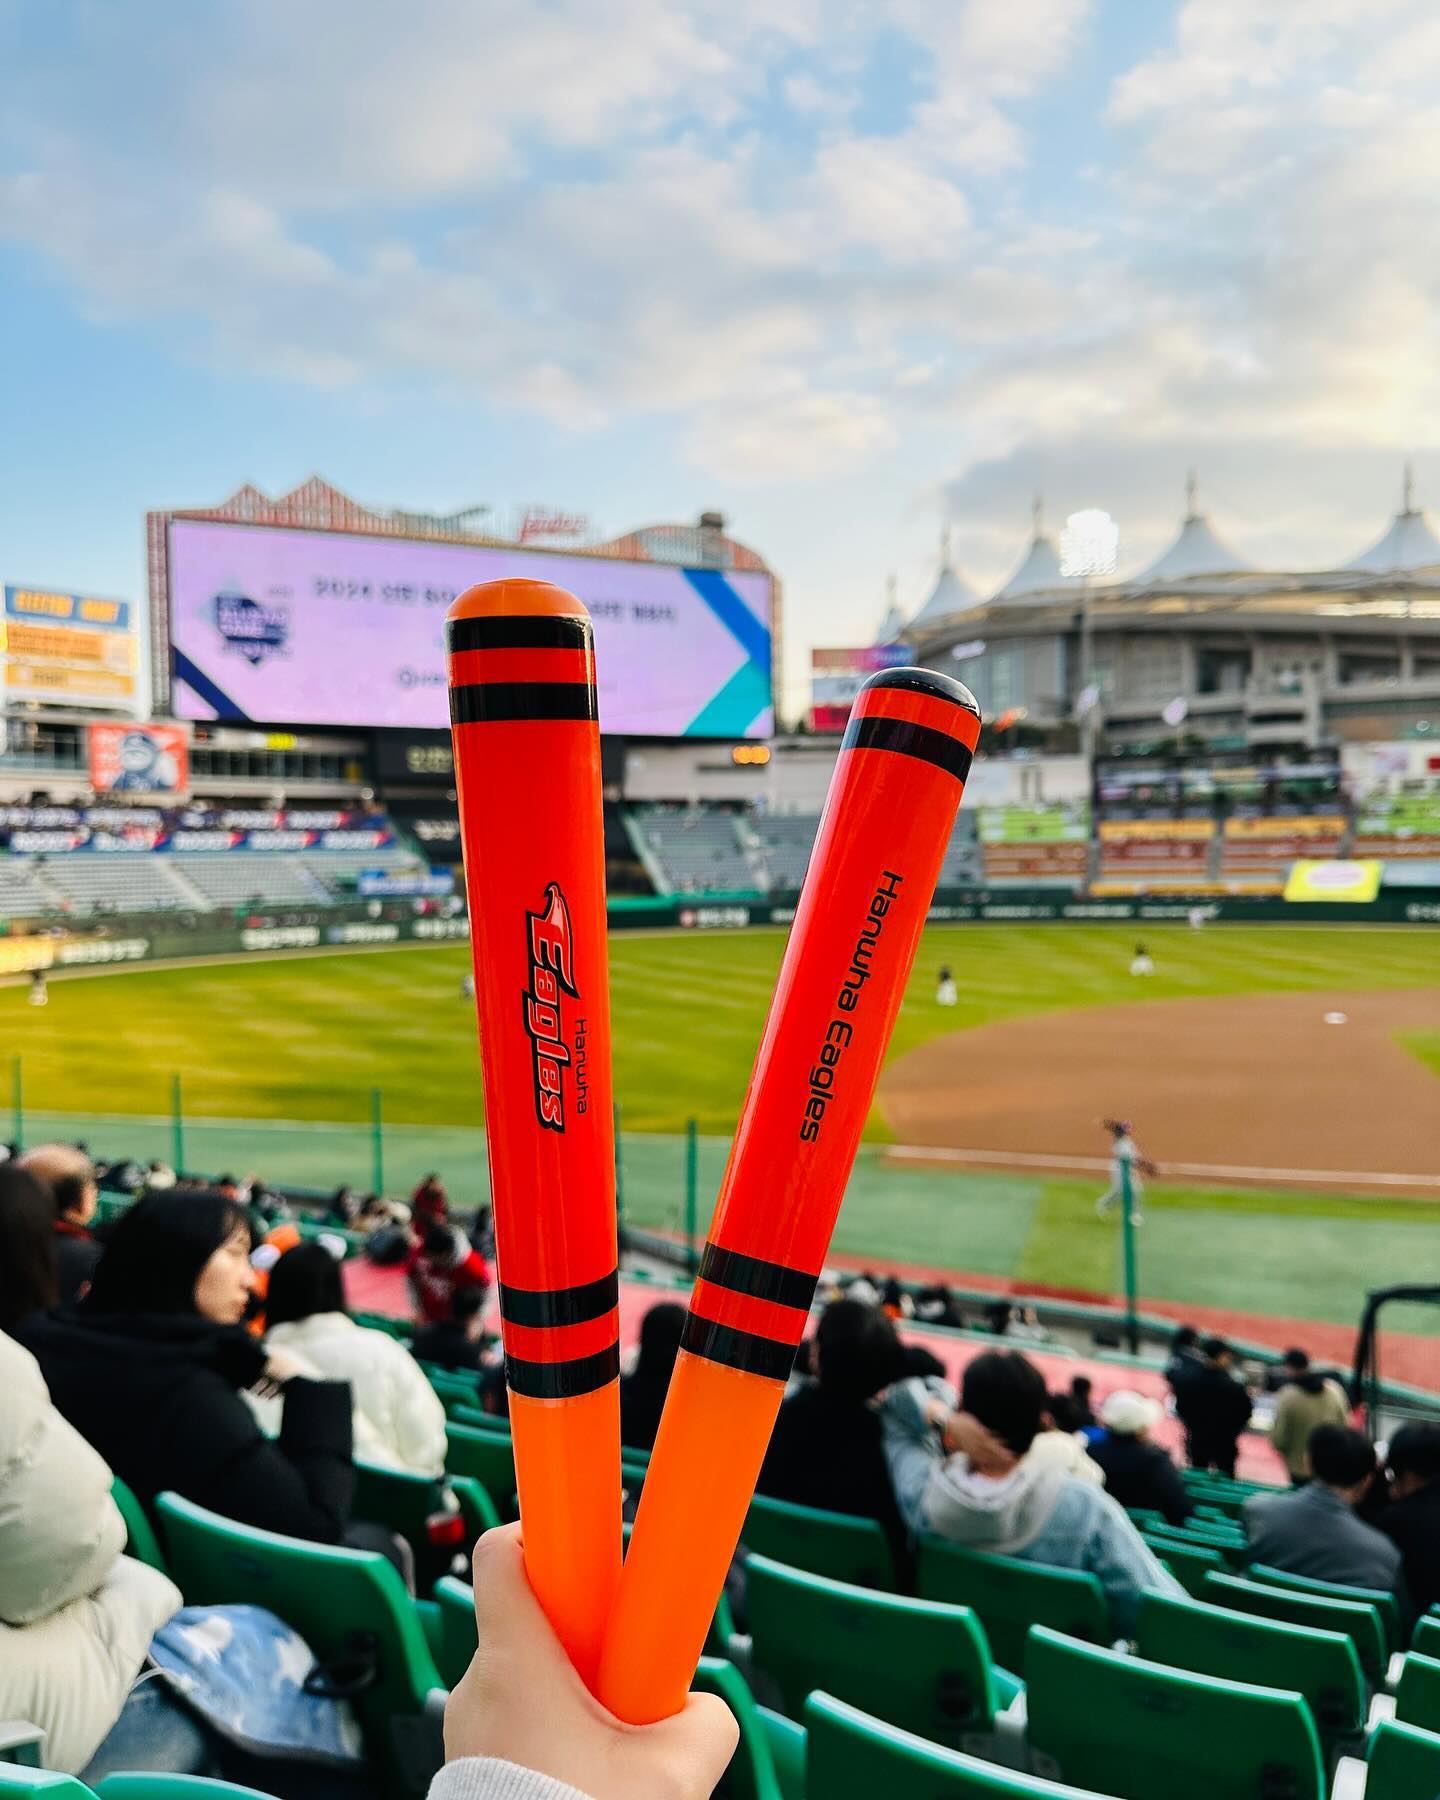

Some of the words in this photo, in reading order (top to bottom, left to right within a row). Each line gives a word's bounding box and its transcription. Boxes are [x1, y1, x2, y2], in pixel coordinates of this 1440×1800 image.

[521, 881, 580, 1134] Eagles
[837, 870, 904, 1013] Hanwha
[574, 1018, 588, 1115] Hanwha
[799, 1019, 854, 1143] Eagles
